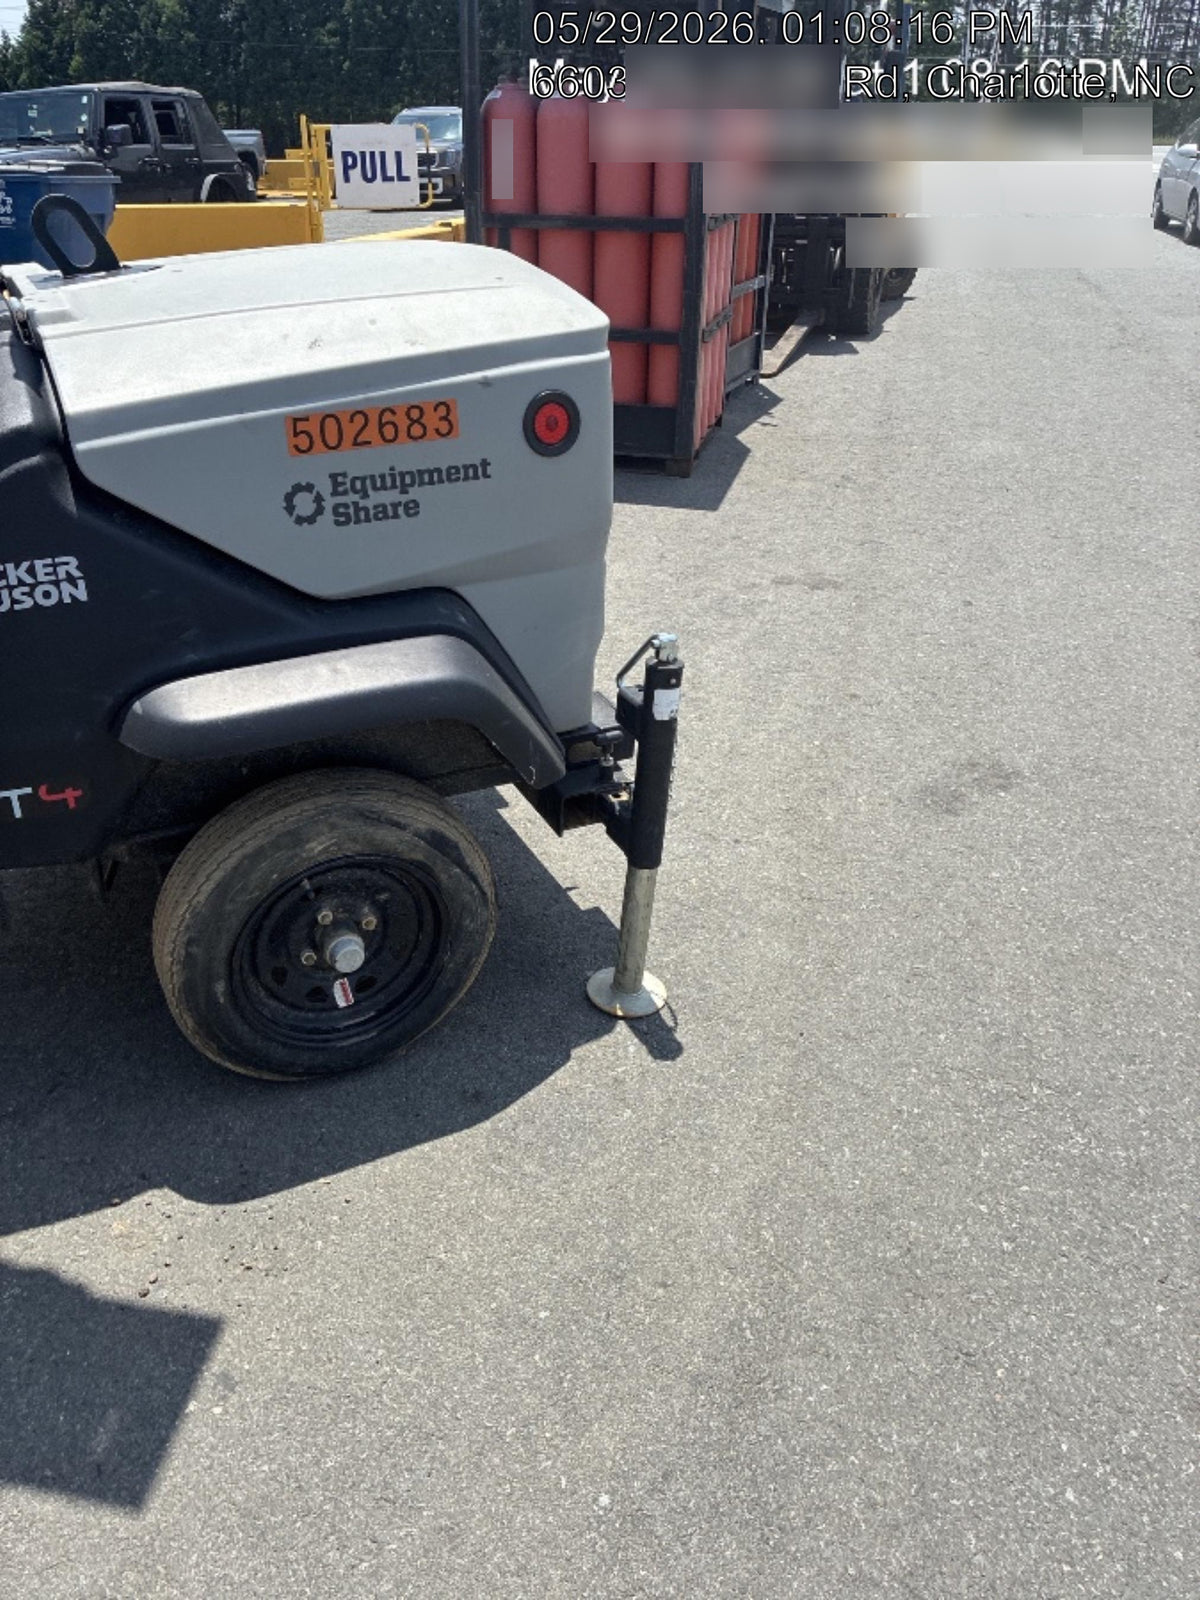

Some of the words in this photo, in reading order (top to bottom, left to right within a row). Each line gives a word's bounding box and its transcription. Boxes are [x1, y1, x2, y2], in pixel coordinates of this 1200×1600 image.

[340, 150, 411, 184] PULL
[291, 401, 455, 454] 502683
[328, 458, 492, 499] Equipment
[331, 499, 420, 527] Share
